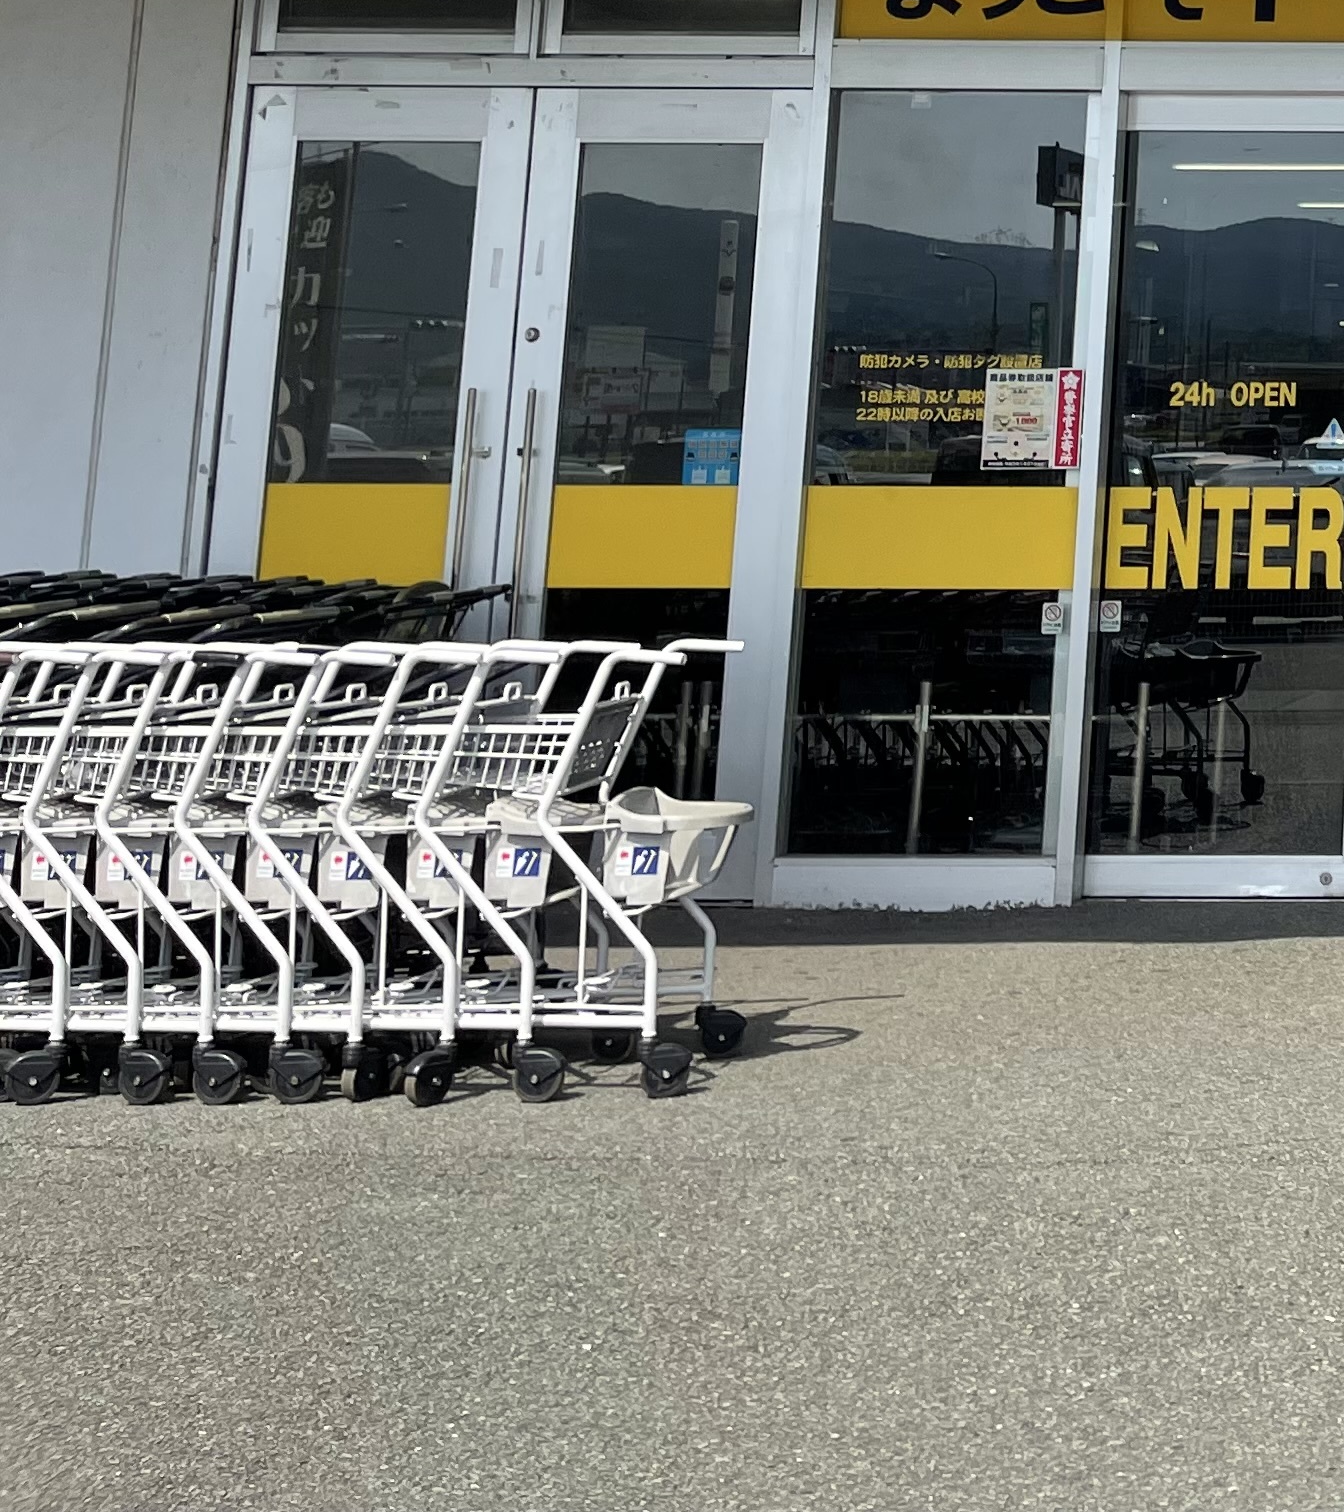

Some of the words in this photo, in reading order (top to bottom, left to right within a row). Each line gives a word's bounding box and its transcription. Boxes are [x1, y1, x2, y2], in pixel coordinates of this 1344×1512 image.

[1169, 381, 1216, 407] 24h
[1230, 381, 1298, 407] OPEN
[1105, 487, 1344, 590] ENTER
